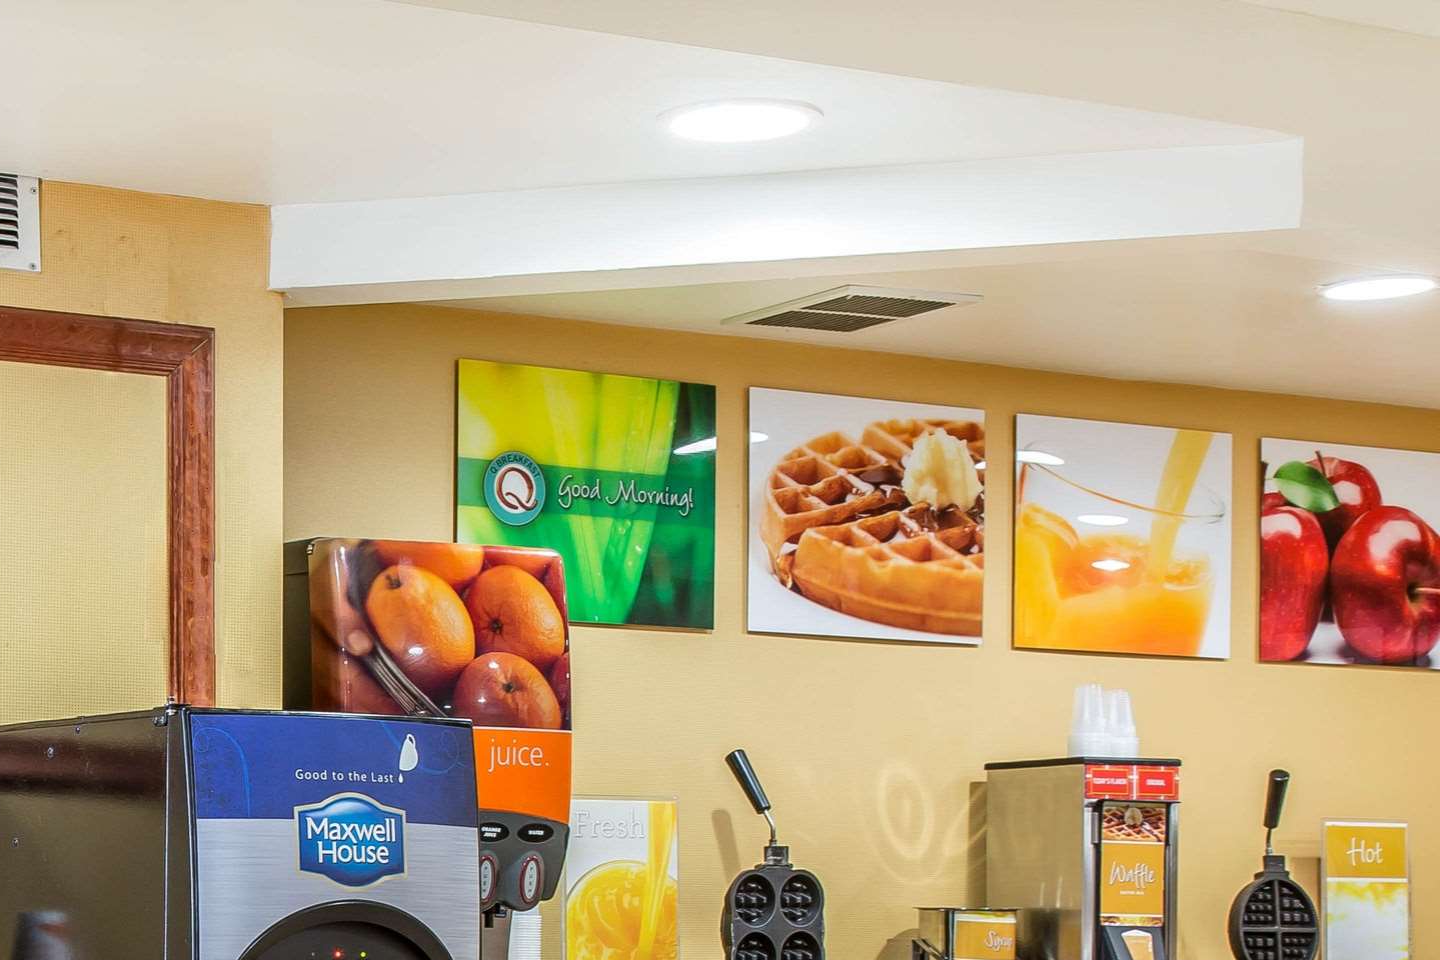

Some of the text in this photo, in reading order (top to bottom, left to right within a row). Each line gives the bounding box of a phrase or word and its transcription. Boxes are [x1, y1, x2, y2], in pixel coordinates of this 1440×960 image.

[496, 455, 541, 478] BREAKFAST
[558, 474, 694, 516] Good Morning!
[487, 737, 550, 773] juice.
[294, 768, 394, 784] Good to the Last
[305, 816, 396, 845] Maxwell
[572, 807, 646, 839] Fresh
[316, 840, 390, 865] House
[1345, 837, 1384, 866] Hot
[1108, 861, 1155, 889] Waffle
